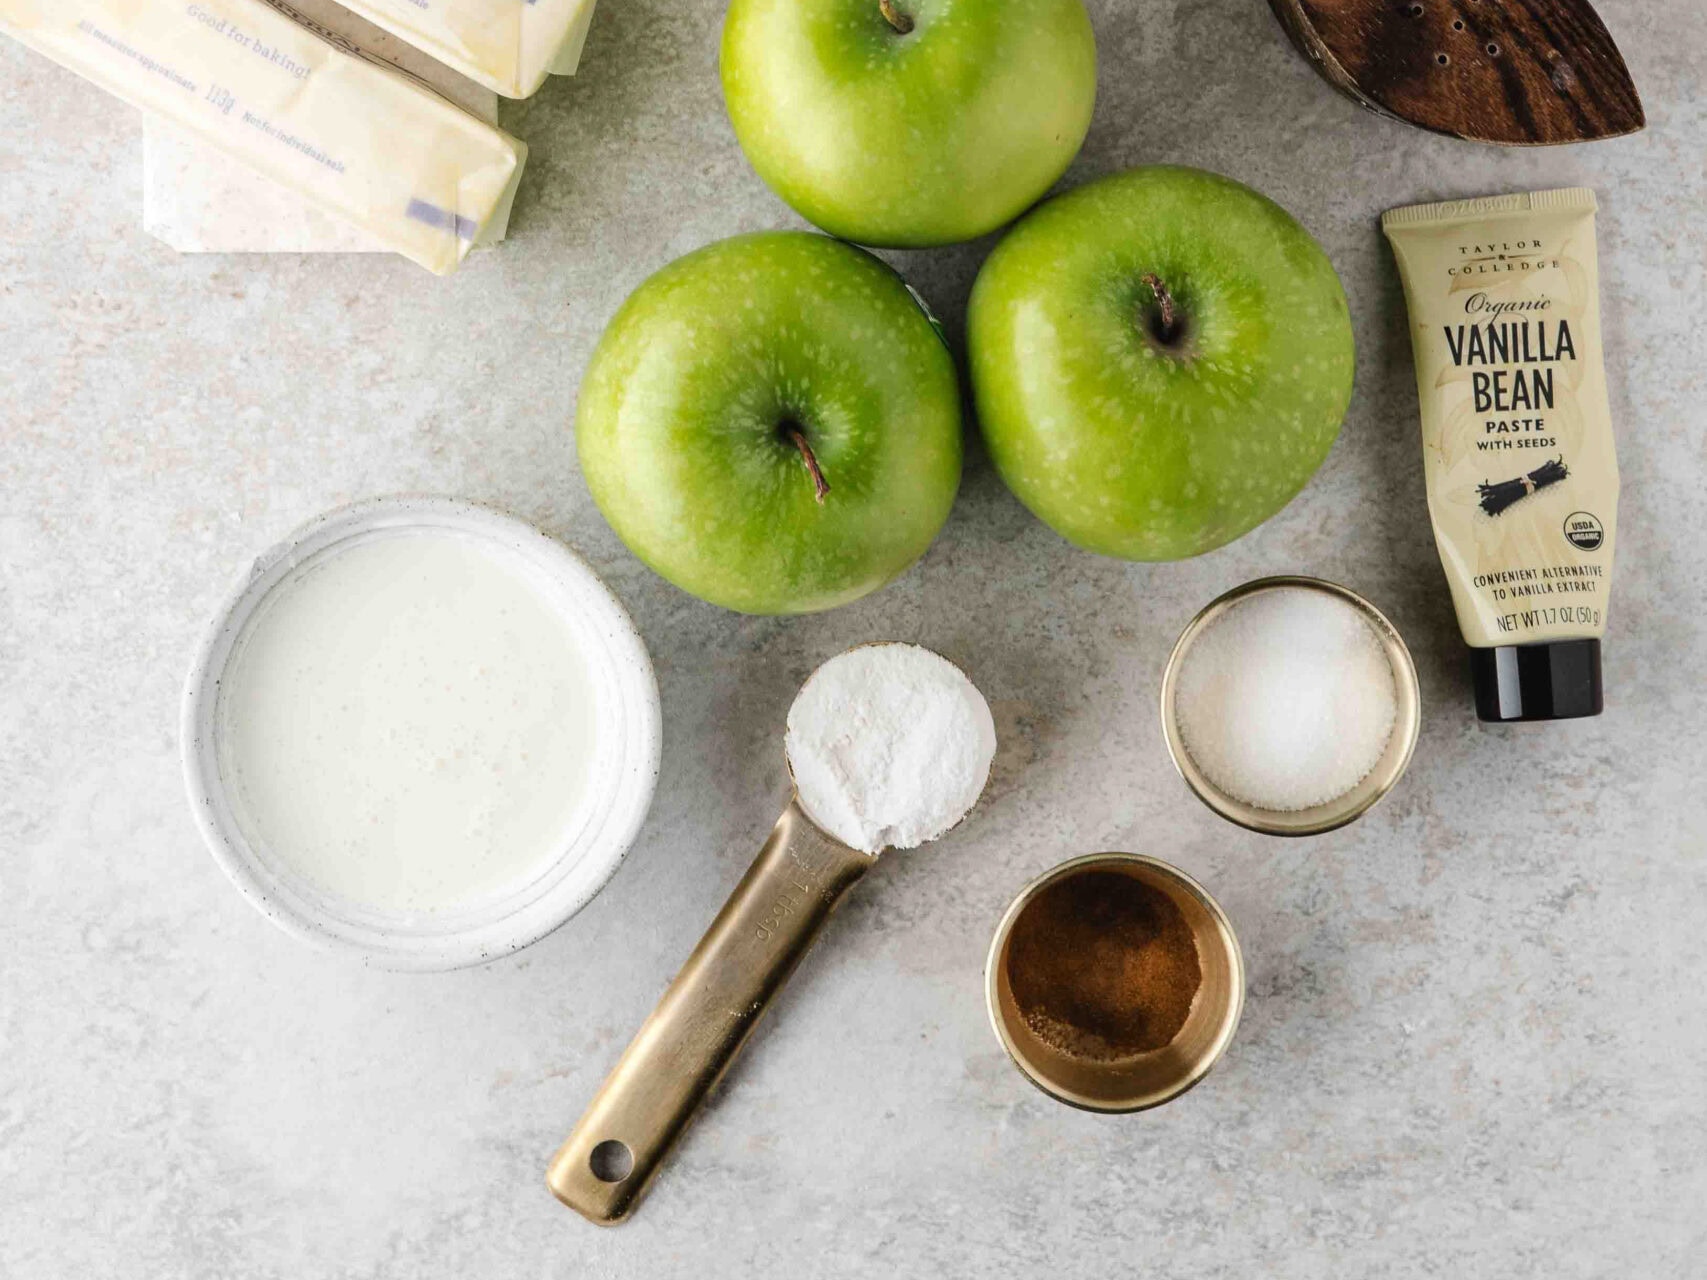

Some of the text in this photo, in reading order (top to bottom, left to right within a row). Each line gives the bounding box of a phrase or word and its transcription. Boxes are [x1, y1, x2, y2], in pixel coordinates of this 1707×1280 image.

[187, 5, 311, 80] Good for baking!
[93, 27, 137, 59] measures
[138, 54, 196, 92] approximate
[205, 84, 236, 115] 113g
[1459, 239, 1543, 255] TAYLOR
[1448, 260, 1561, 276] COLLEDGE
[1464, 292, 1552, 323] Organic
[1444, 320, 1576, 366] VANILLA
[1472, 368, 1554, 413] BEAN
[1486, 419, 1545, 433] PASTE
[1477, 437, 1556, 451] WITH SEEDS
[1571, 521, 1595, 531] USDA
[1473, 565, 1603, 588] CONVENIENT ALTERNATIVE
[1493, 581, 1596, 601] TO VANILLA EXTRACT
[1496, 613, 1518, 632] NET
[1520, 610, 1540, 628] WT
[1543, 608, 1556, 625] 1.7
[1560, 607, 1574, 623] OZ
[755, 880, 809, 941] 1 tbsp
